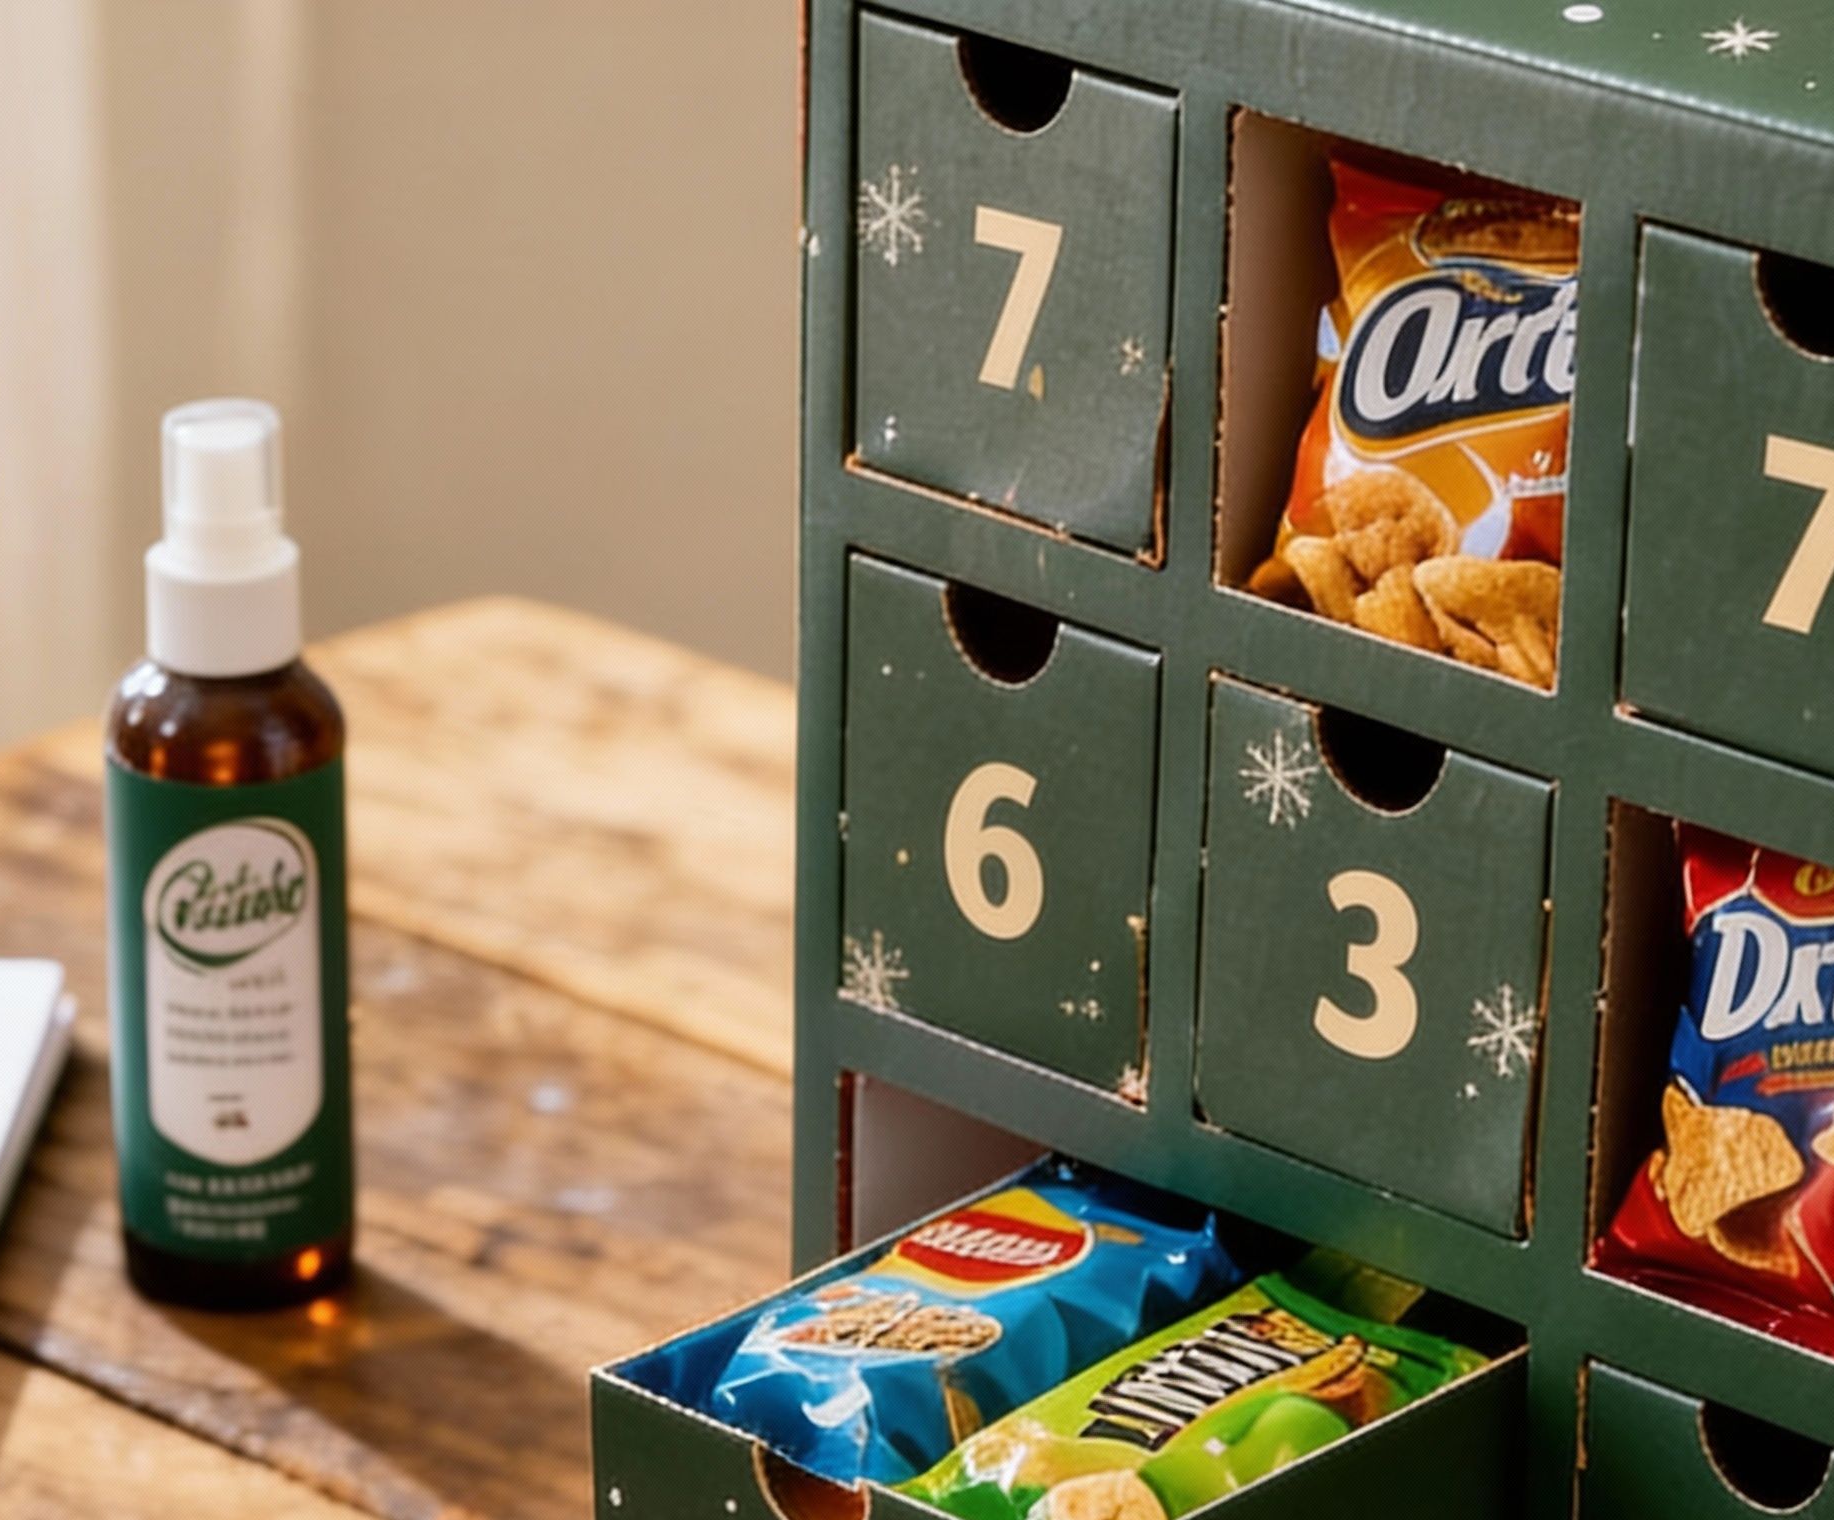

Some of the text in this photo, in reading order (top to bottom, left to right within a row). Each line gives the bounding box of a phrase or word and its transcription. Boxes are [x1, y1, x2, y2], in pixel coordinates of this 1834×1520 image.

[973, 203, 1064, 391] 7
[943, 761, 1045, 940] 6
[1313, 869, 1420, 1060] 3
